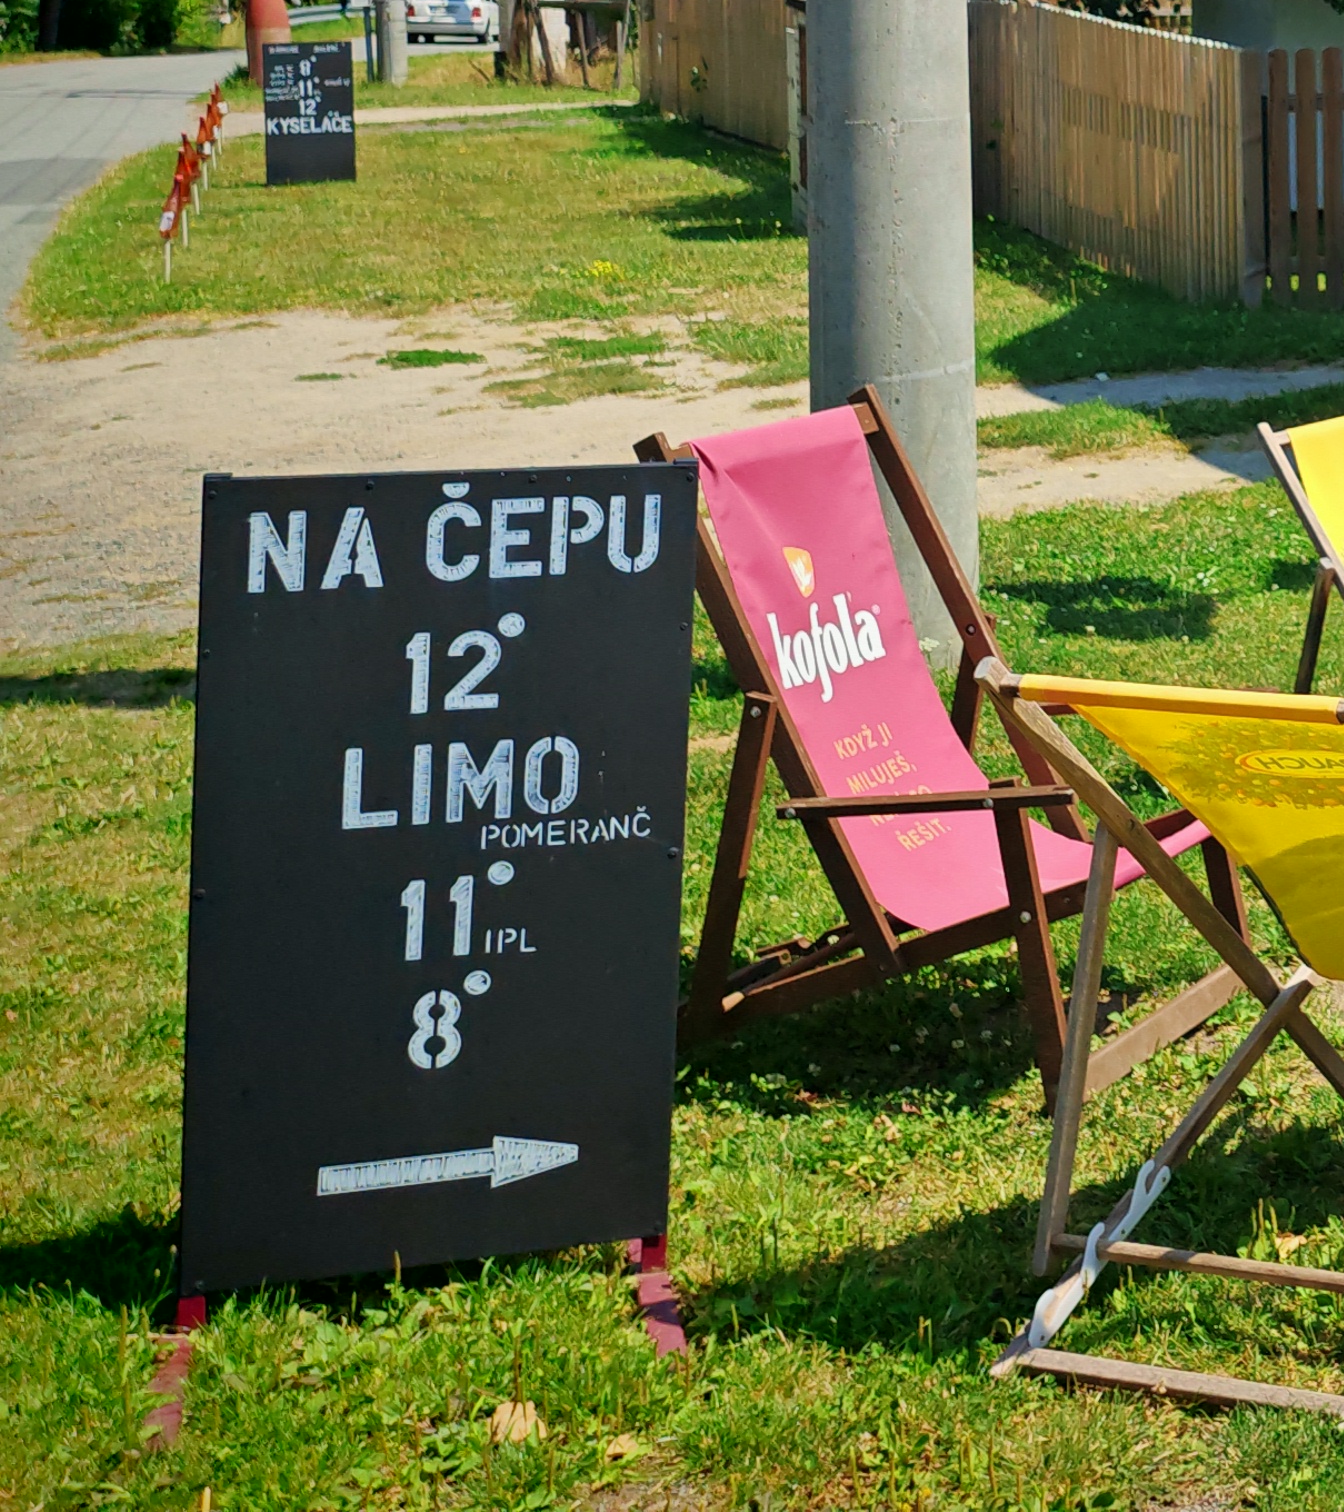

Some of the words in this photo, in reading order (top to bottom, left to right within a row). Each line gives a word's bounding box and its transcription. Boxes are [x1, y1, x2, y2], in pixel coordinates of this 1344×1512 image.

[247, 506, 383, 593] NA
[425, 482, 661, 581] ČEPU
[405, 612, 525, 714] 12°
[766, 593, 887, 703] kofola
[342, 736, 579, 830] LIMO
[833, 723, 878, 760] KDYŽ
[877, 722, 893, 747] JI
[845, 750, 918, 795] MILUJEŠ,
[480, 805, 652, 850] POMERANČ
[894, 817, 952, 852] ŘEŠIT.
[401, 860, 516, 961] 11°
[484, 927, 538, 954] IPL
[407, 970, 492, 1069] 8°
